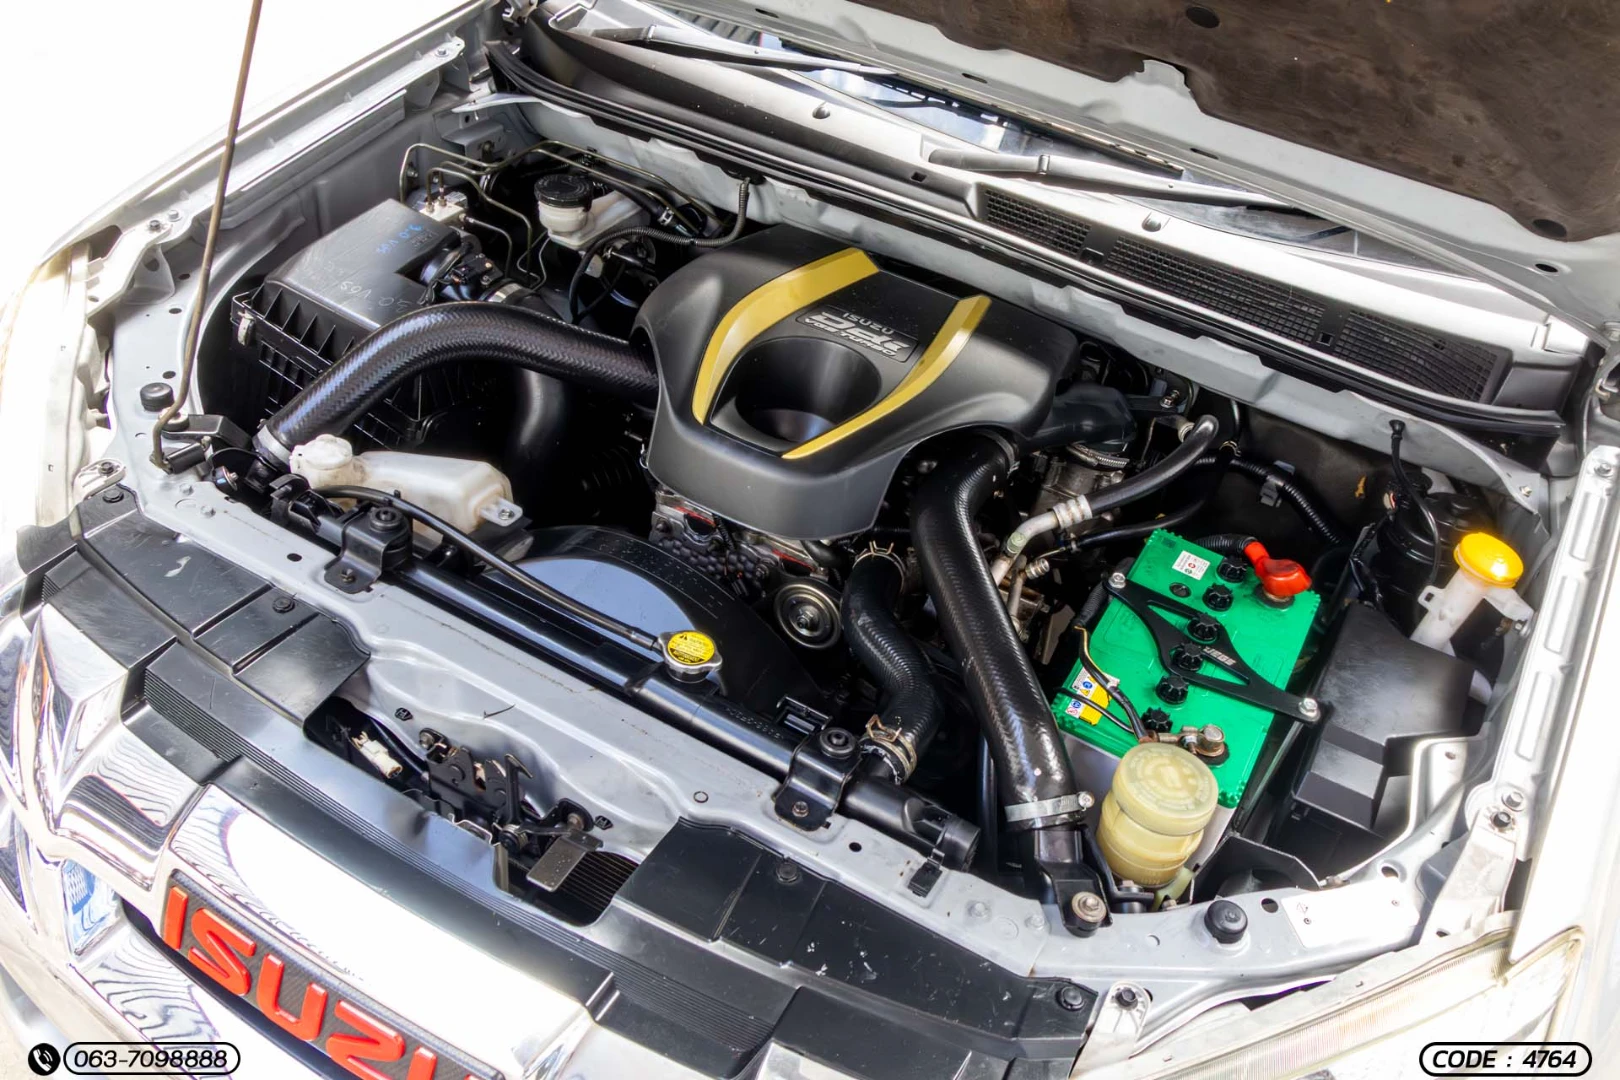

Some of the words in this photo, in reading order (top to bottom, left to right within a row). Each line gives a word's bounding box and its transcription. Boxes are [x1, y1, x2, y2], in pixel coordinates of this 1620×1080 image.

[843, 312, 896, 335] ISUZU
[840, 332, 897, 357] TURBO
[161, 885, 482, 1080] ISUZ
